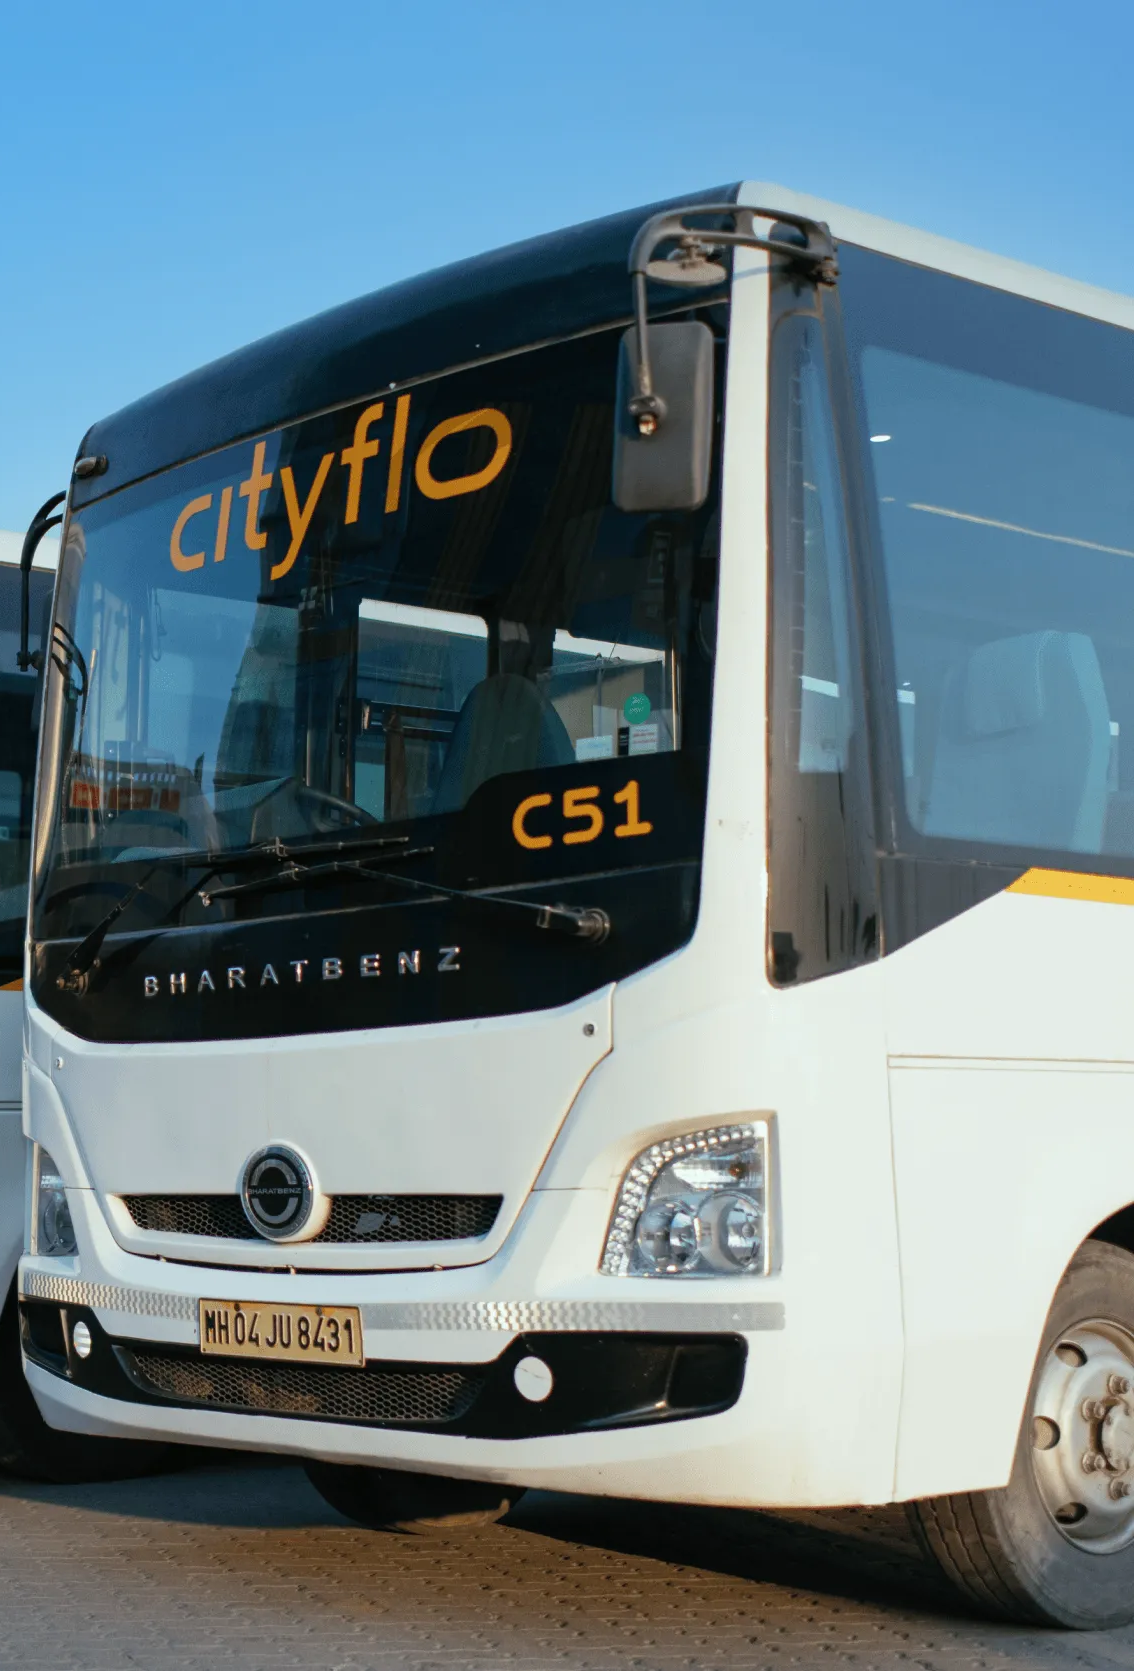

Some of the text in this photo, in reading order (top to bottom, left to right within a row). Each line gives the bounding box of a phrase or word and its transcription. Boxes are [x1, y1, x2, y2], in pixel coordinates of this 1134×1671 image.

[169, 393, 512, 581] cityflo
[512, 779, 653, 849] C51
[144, 946, 461, 997] BHARATBENZ
[247, 1187, 302, 1195] BHARATBENZ
